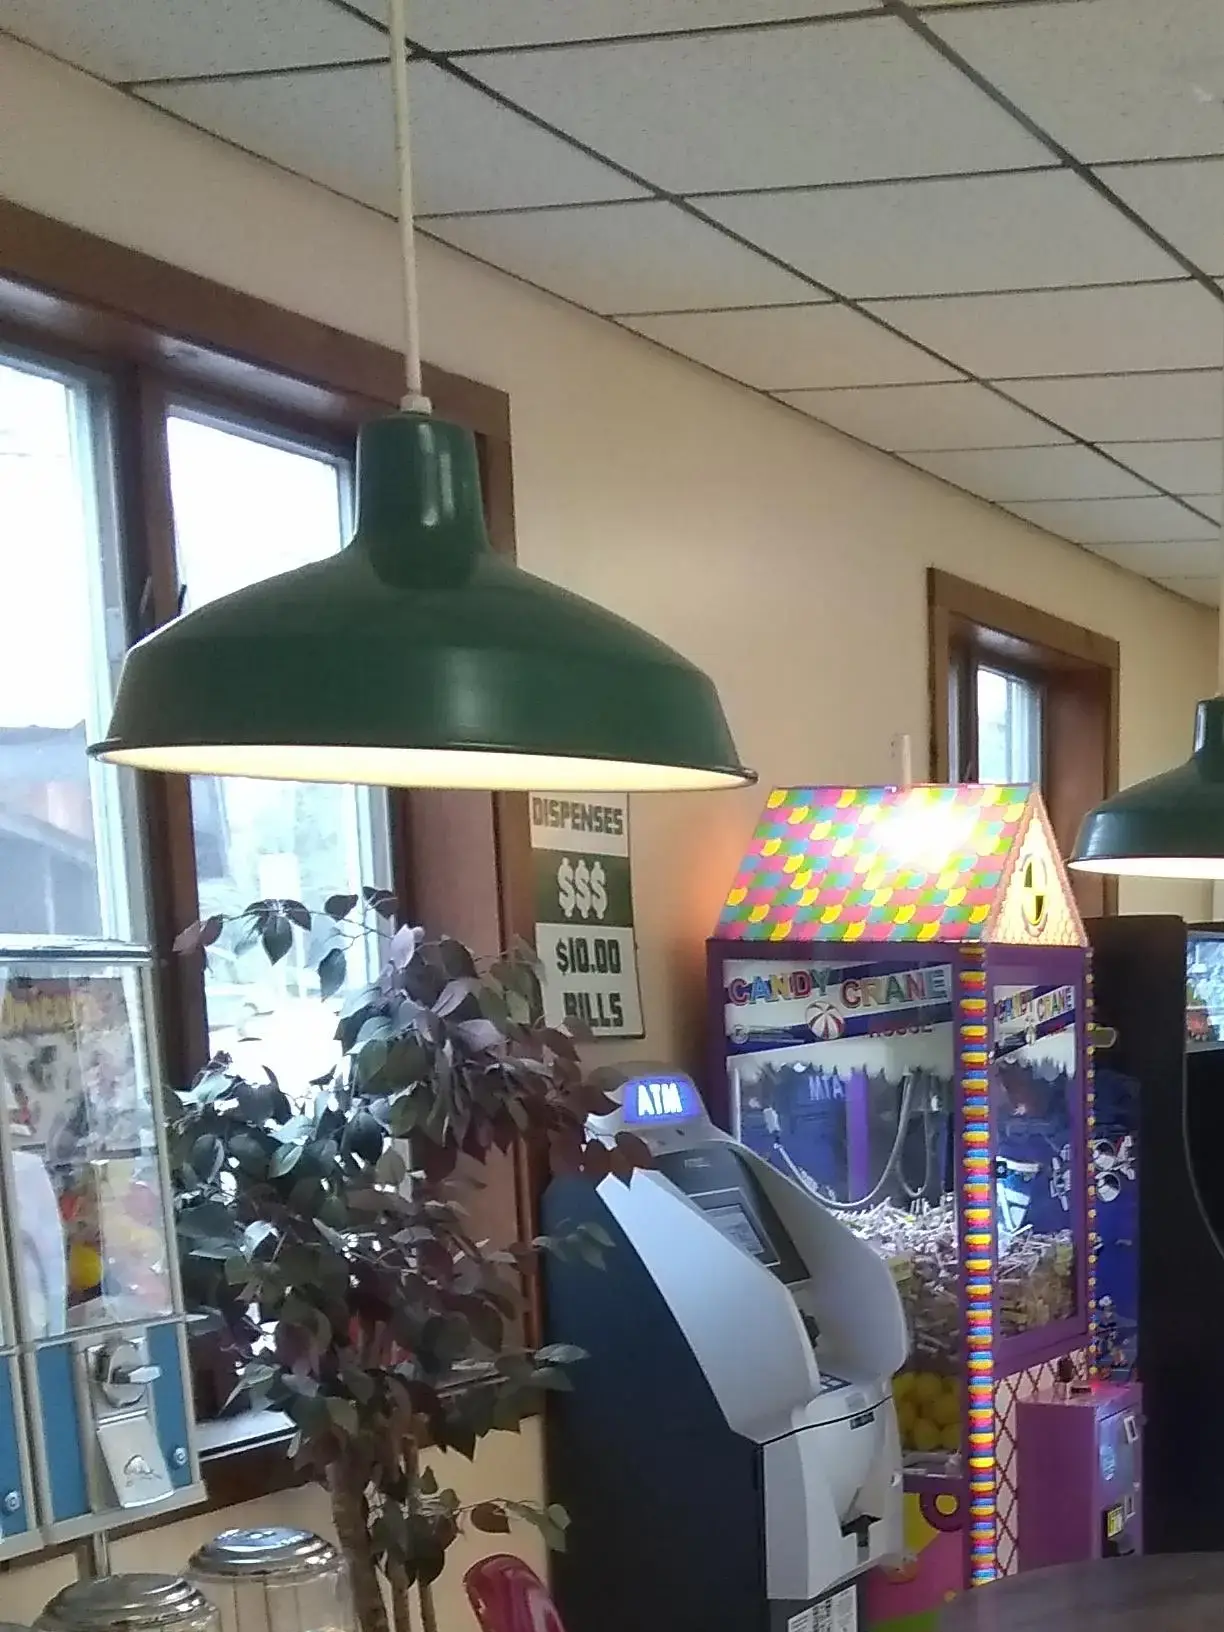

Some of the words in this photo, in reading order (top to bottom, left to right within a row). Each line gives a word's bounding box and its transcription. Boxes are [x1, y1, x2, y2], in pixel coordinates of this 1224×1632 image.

[532, 796, 623, 836] DISPENSES
[557, 857, 608, 920] $$$
[556, 937, 622, 975] $10.00
[728, 966, 833, 1006] CANDY
[840, 968, 949, 1009] CRANE
[637, 1082, 683, 1117] ATM
